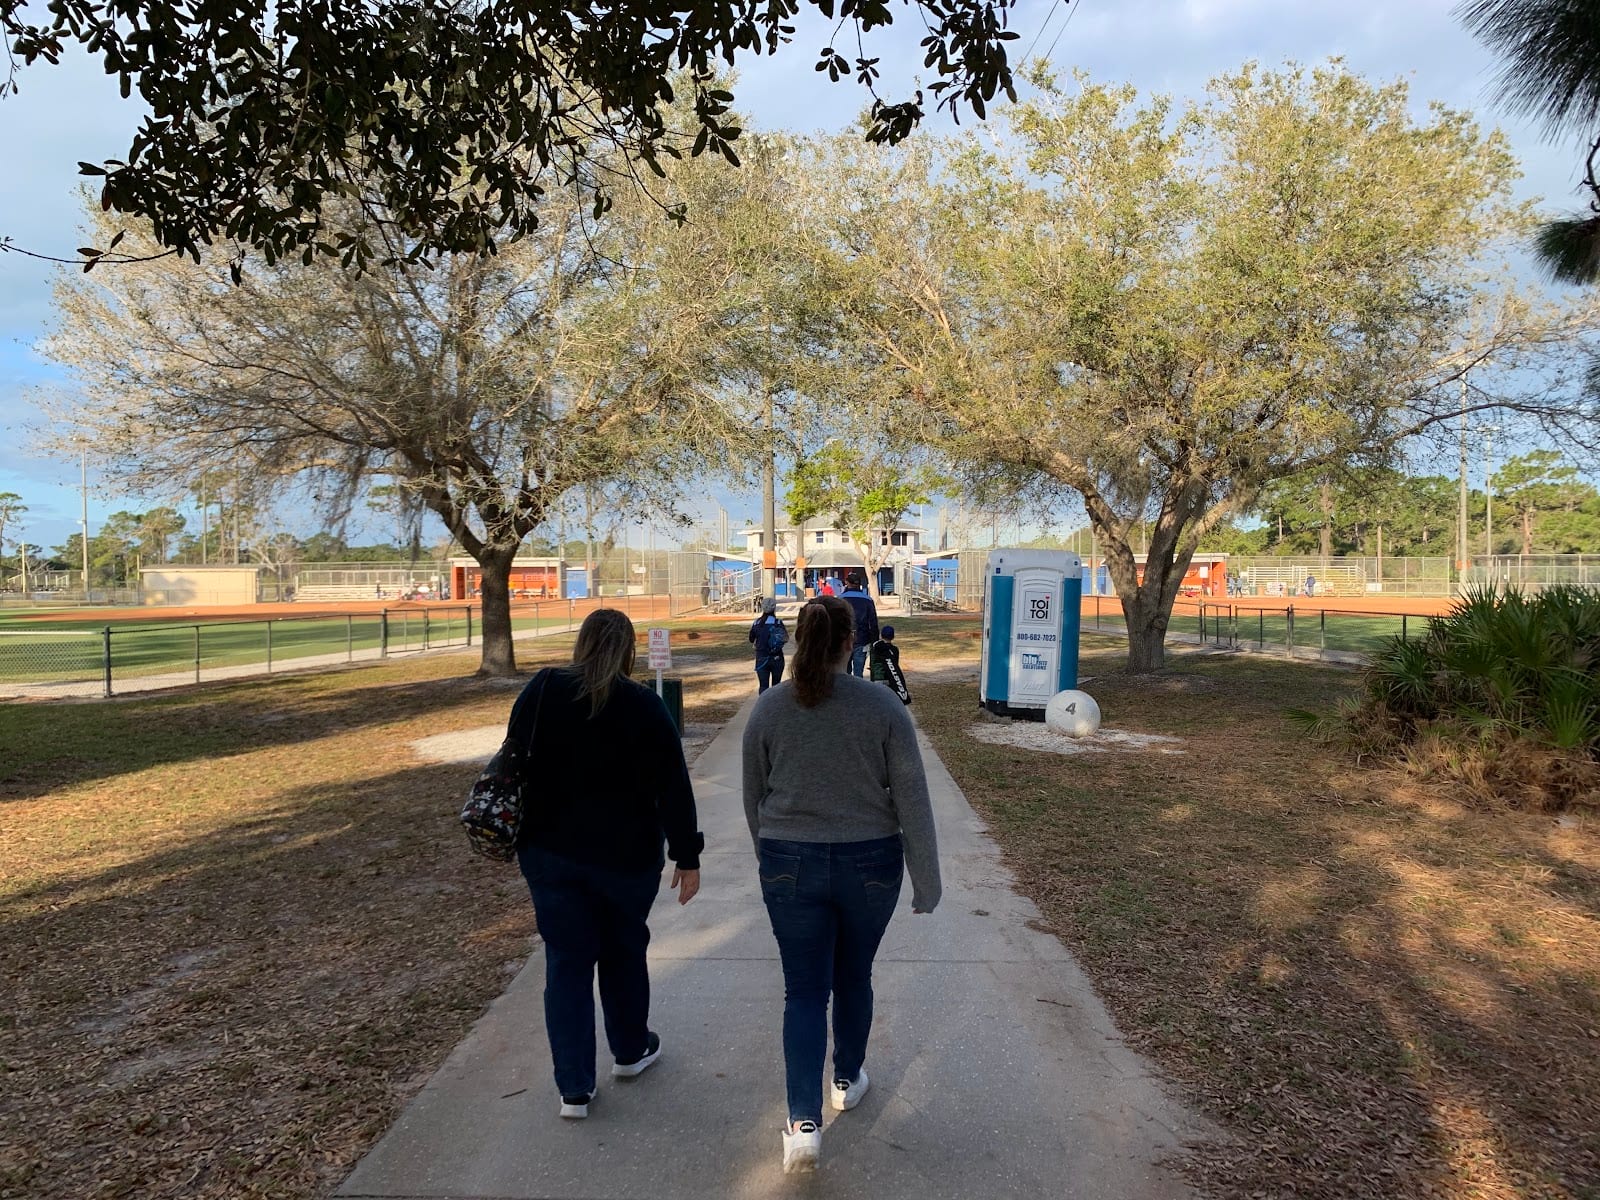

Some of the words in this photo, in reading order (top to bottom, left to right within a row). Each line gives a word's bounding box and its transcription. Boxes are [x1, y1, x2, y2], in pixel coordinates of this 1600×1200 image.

[1029, 609, 1048, 620] TOI
[653, 630, 663, 639] NO
[1017, 633, 1057, 642] 800-682-7023
[885, 658, 906, 692] EASTON
[1065, 702, 1076, 715] 4
